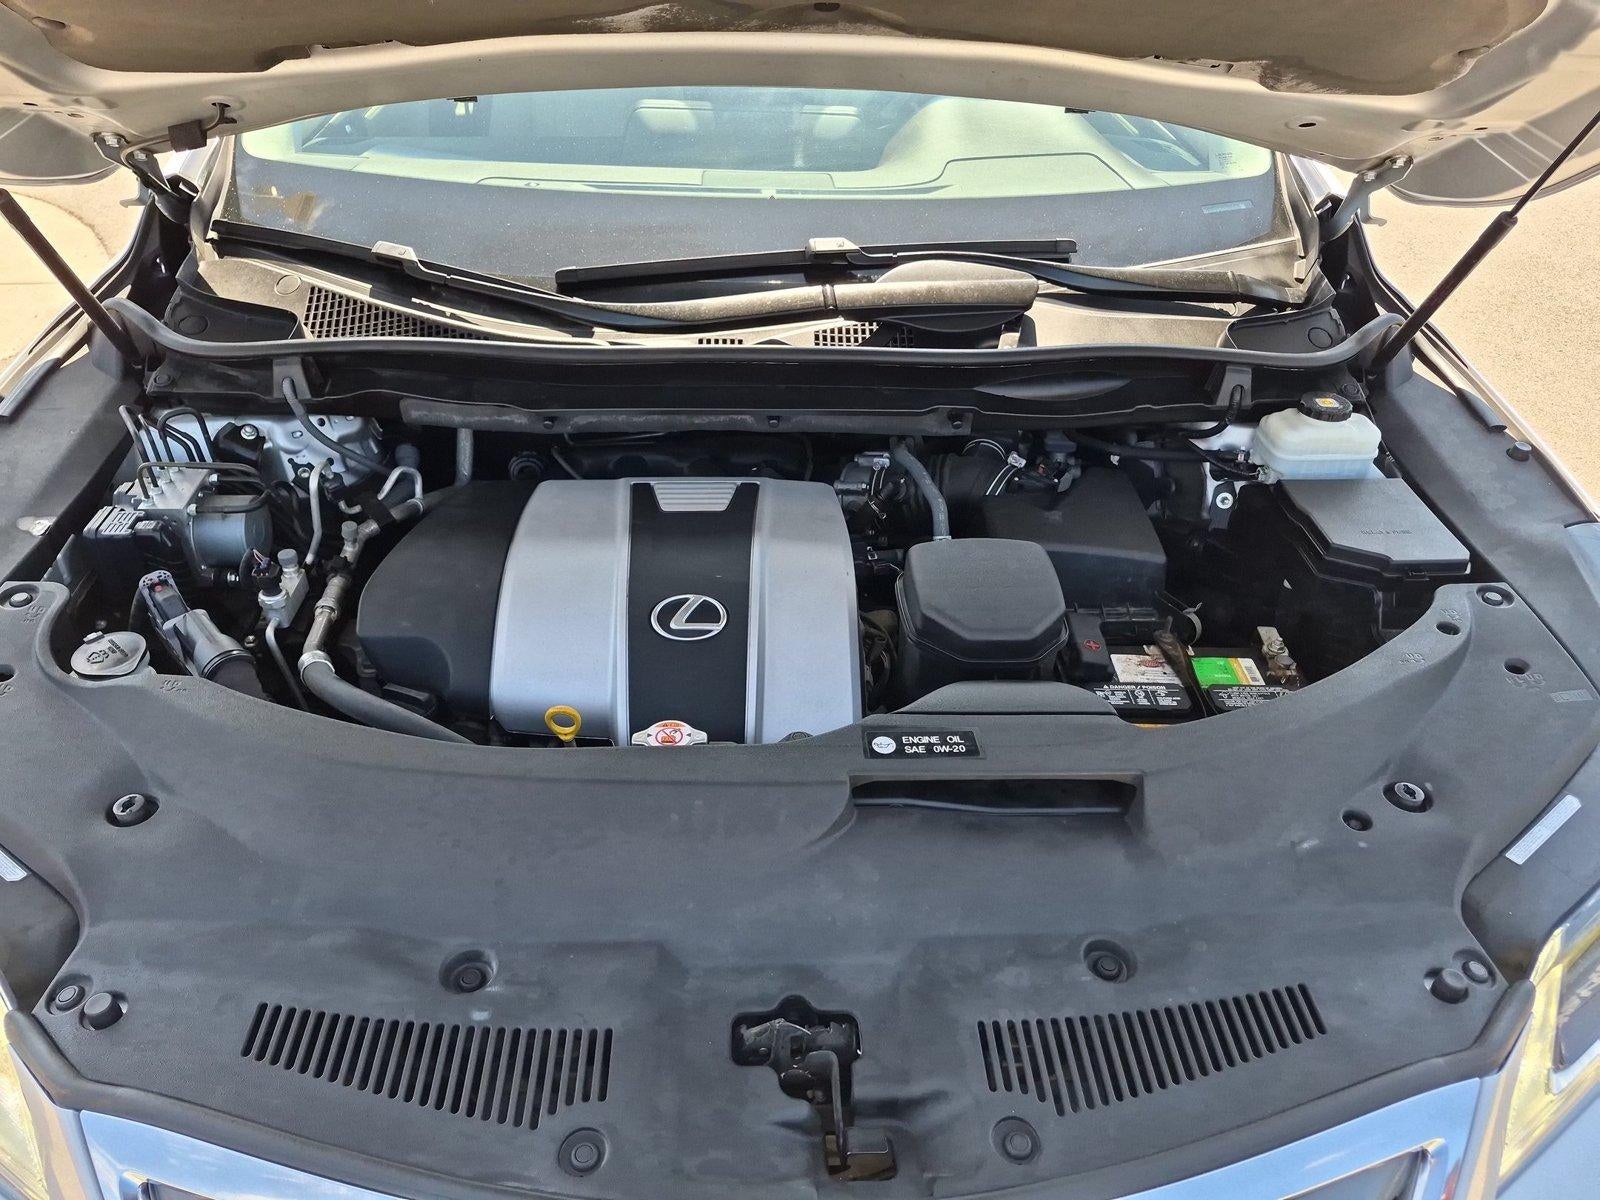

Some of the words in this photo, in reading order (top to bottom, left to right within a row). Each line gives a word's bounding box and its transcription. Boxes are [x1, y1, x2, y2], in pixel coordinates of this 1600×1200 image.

[902, 736, 940, 744] ENGINE
[946, 735, 965, 743] OIL
[904, 745, 927, 754] SAE
[933, 745, 966, 753] 0W-20
